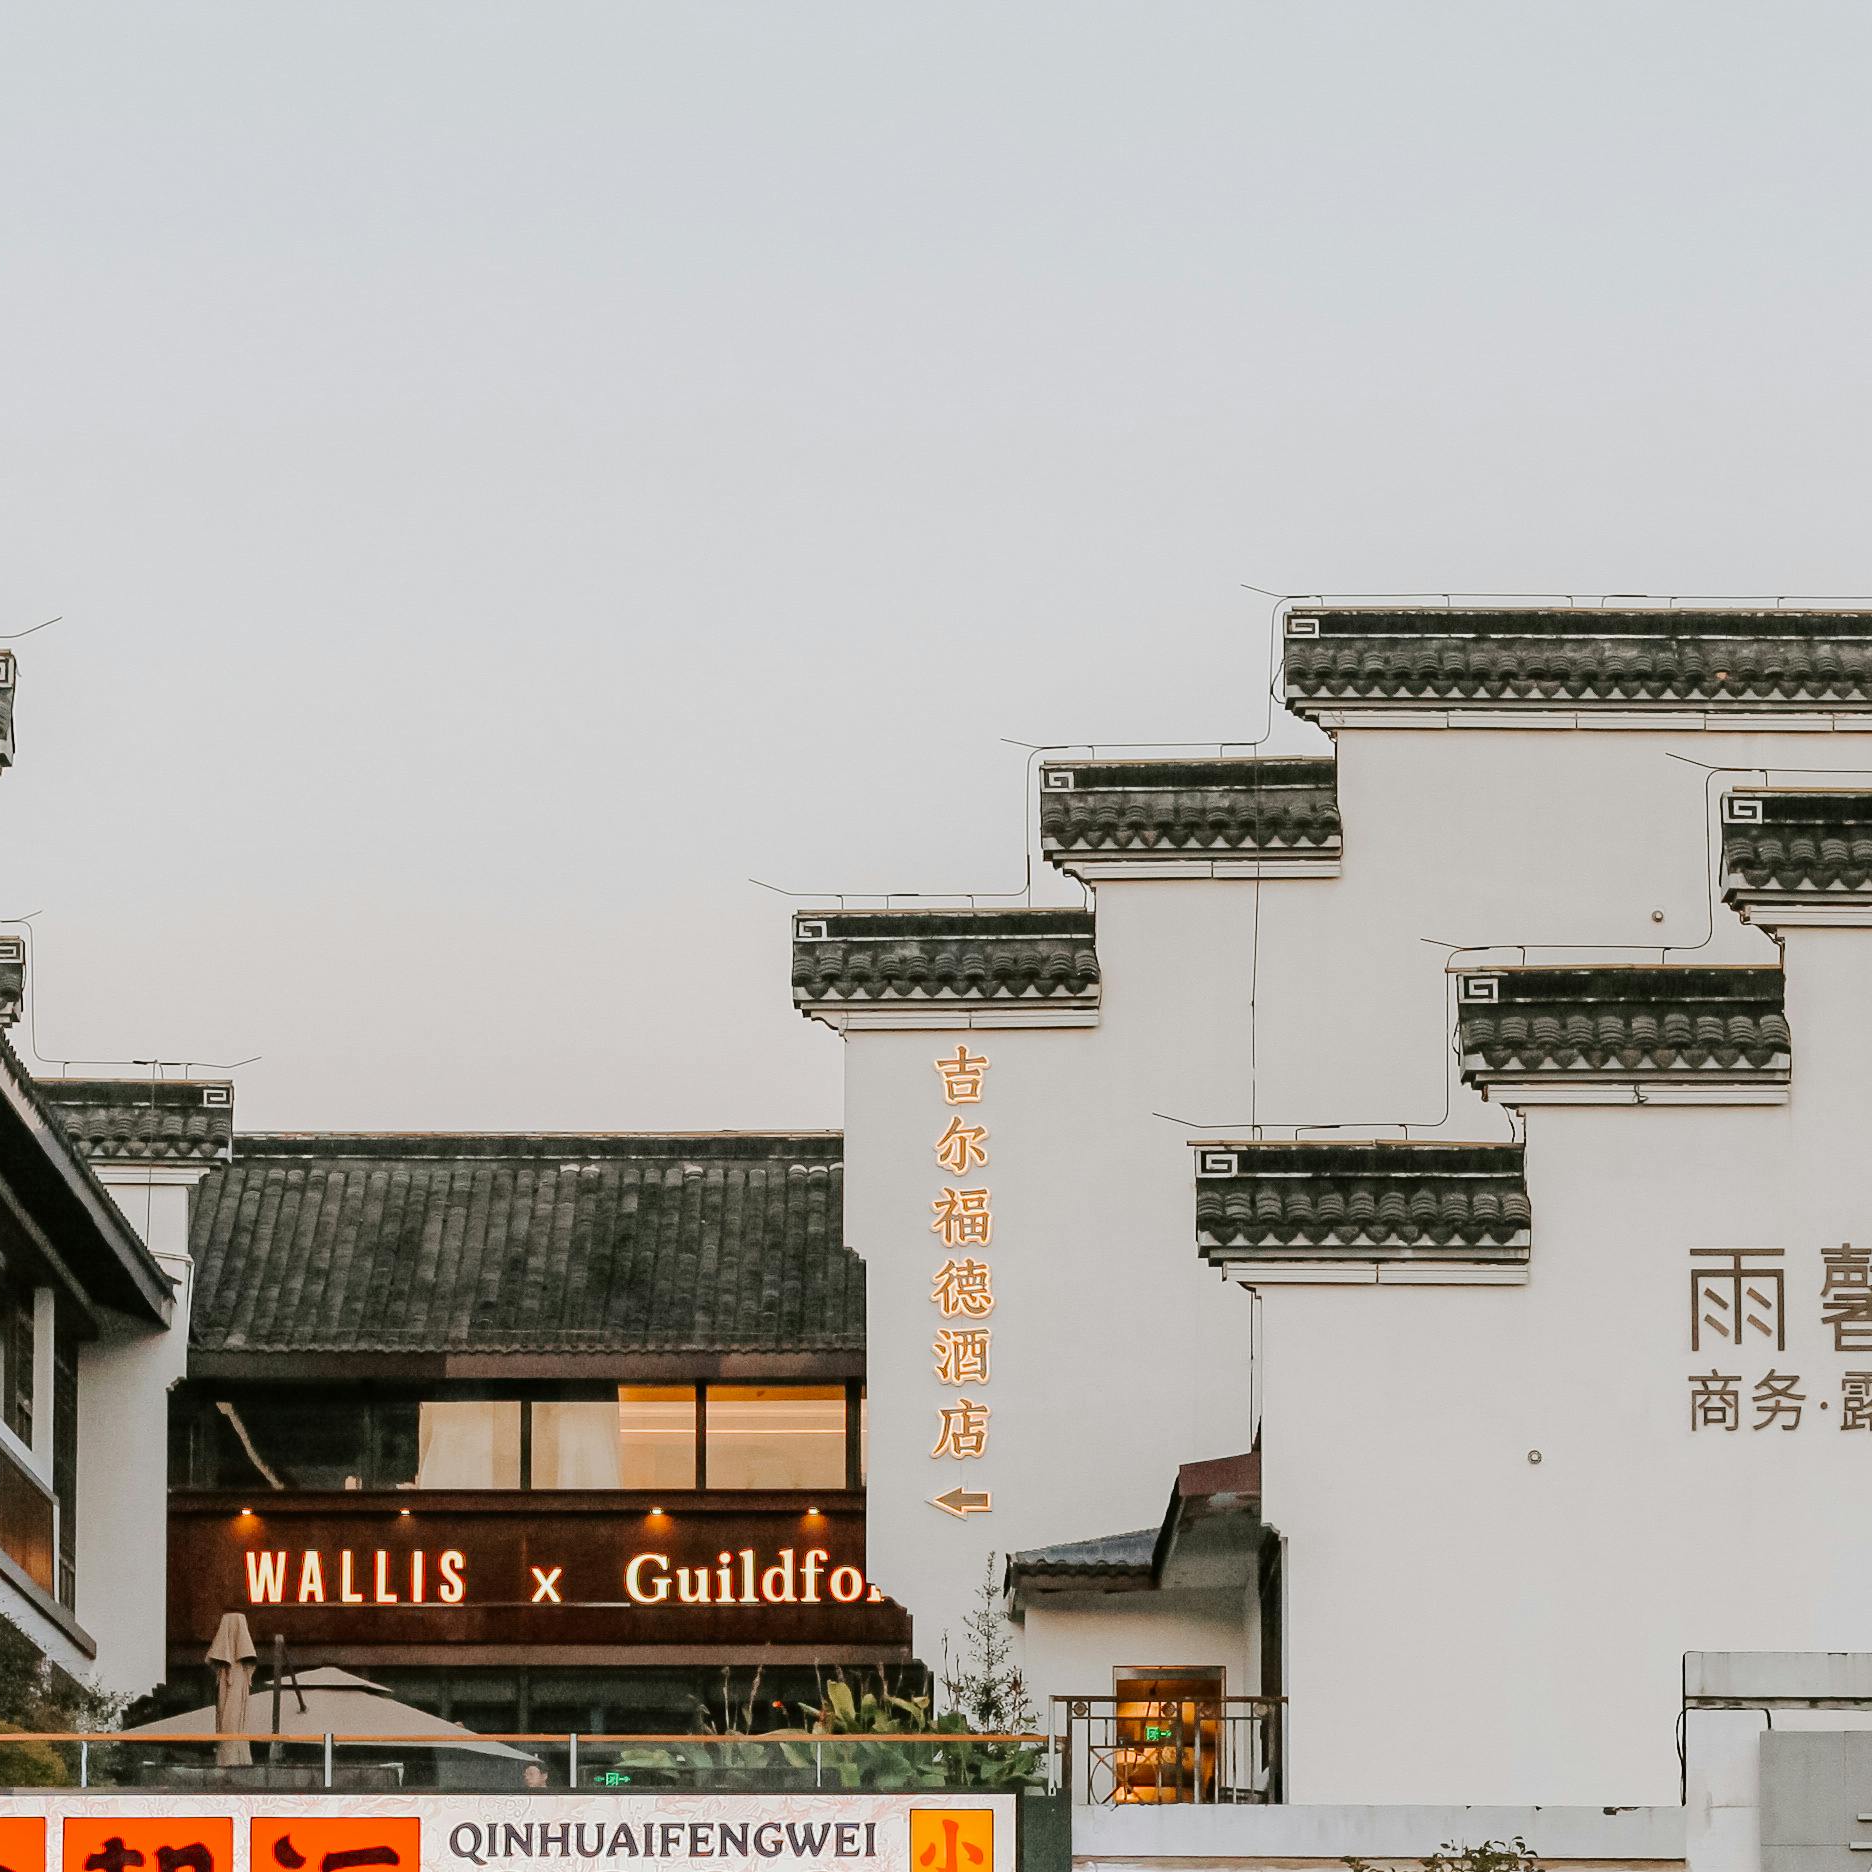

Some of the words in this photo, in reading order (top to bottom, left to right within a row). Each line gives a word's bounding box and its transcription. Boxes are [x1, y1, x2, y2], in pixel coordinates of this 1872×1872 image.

[931, 1044, 993, 1460] 吉尔福德酒店
[244, 1550, 468, 1604] WALLIS
[449, 1821, 877, 1867] QINHUAIFENGWEI
